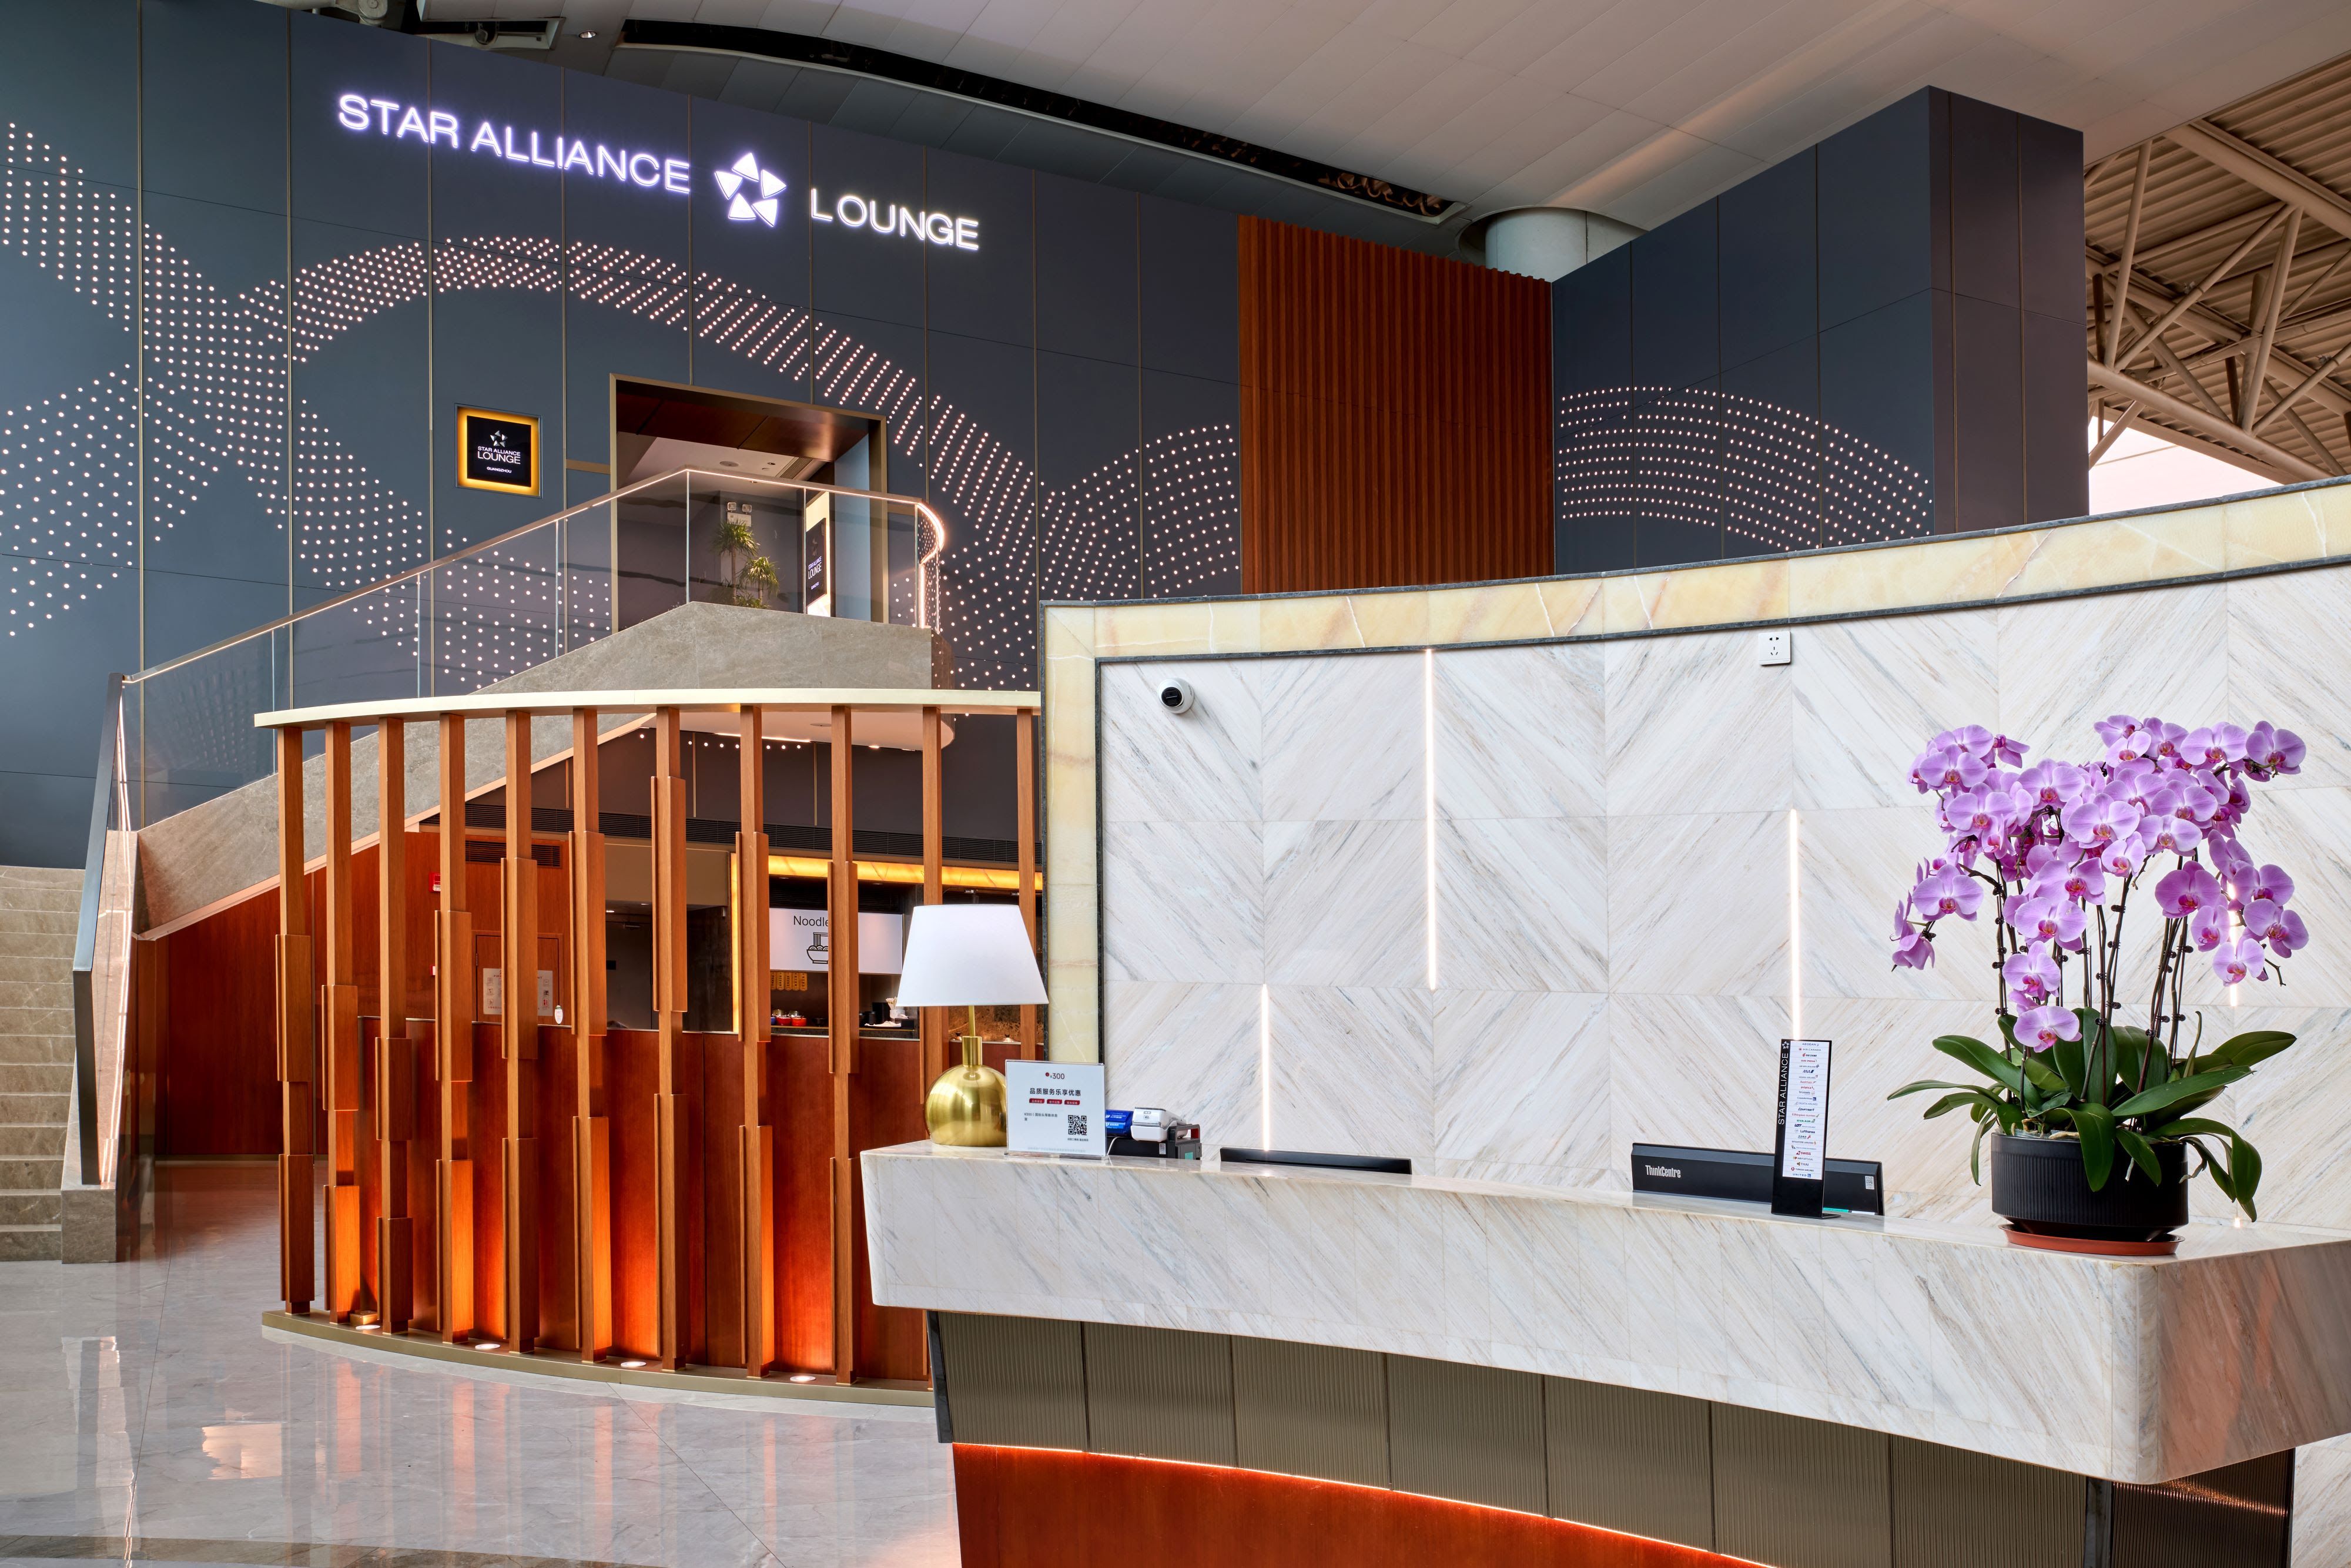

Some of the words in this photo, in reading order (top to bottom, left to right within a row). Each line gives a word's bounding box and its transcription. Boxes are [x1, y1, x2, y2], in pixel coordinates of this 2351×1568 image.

[338, 93, 459, 149] STAR
[470, 121, 691, 195] ALLIANCE
[810, 187, 979, 251] LOUNGE
[477, 451, 521, 464] LOUNGE
[493, 448, 521, 457] ALLIANCE
[808, 562, 822, 579] LOUNGE
[1780, 1053, 1789, 1098] ALLIANCE
[1030, 1088, 1081, 1096] 品质服务乐享优惠
[1645, 1165, 1681, 1178] ThinkCentre
